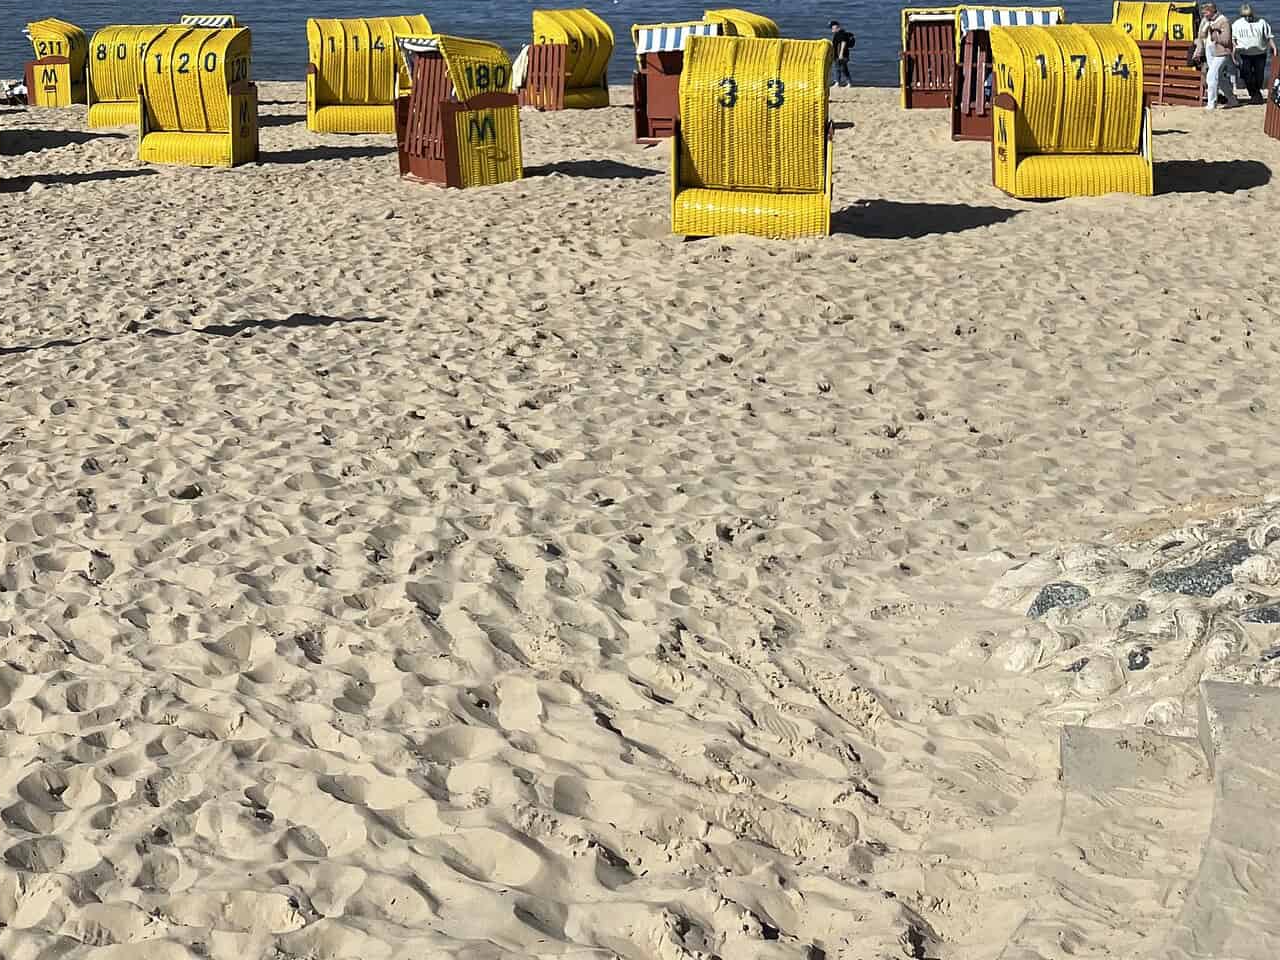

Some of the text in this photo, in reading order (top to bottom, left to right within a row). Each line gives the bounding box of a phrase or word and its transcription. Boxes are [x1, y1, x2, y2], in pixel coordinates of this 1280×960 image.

[39, 41, 62, 56] 211
[328, 35, 385, 53] 114
[155, 52, 217, 74] 120
[1035, 53, 1130, 80] 174
[42, 68, 58, 83] M
[465, 64, 506, 90] 180
[720, 76, 785, 108] 33
[468, 113, 496, 144] M
